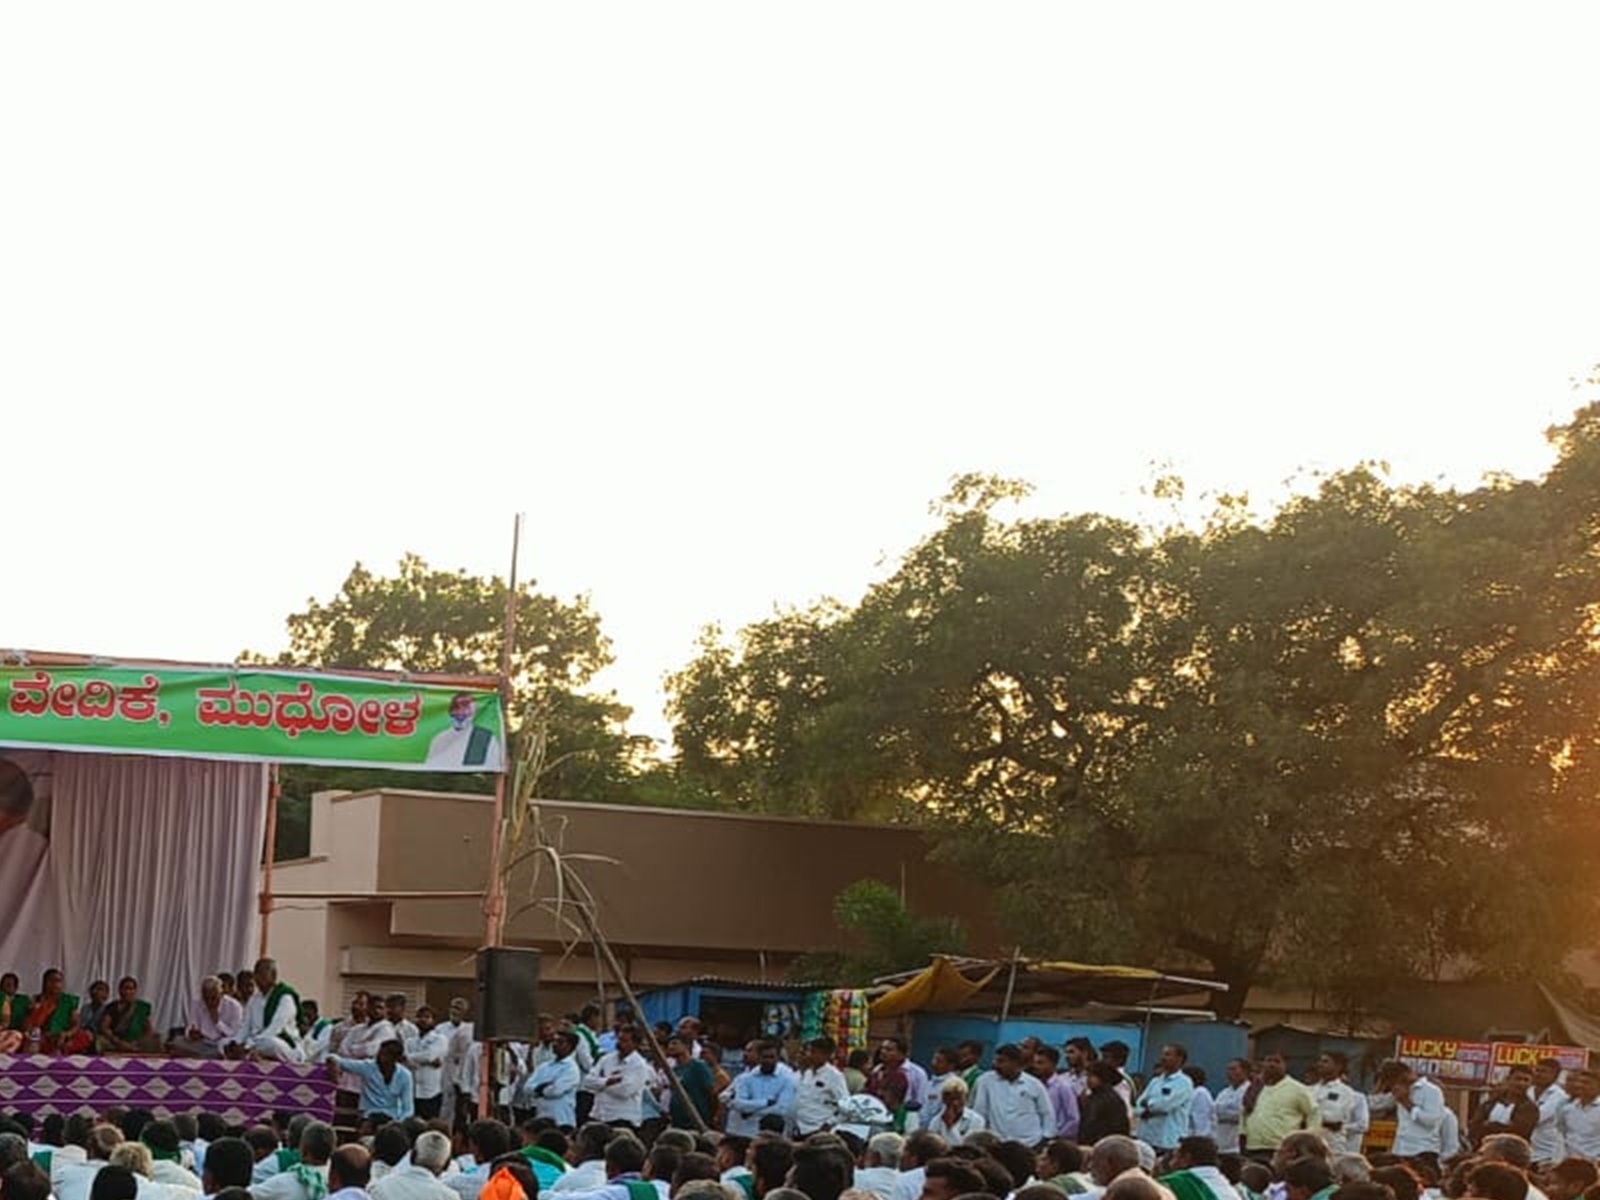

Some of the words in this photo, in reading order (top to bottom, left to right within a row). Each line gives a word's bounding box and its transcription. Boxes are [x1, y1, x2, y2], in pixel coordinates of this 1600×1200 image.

[9, 671, 171, 727] ವೇದಿಕೆ,
[196, 679, 423, 737] ಮುಧೋಳ
[1401, 1038, 1457, 1059] LUCKY
